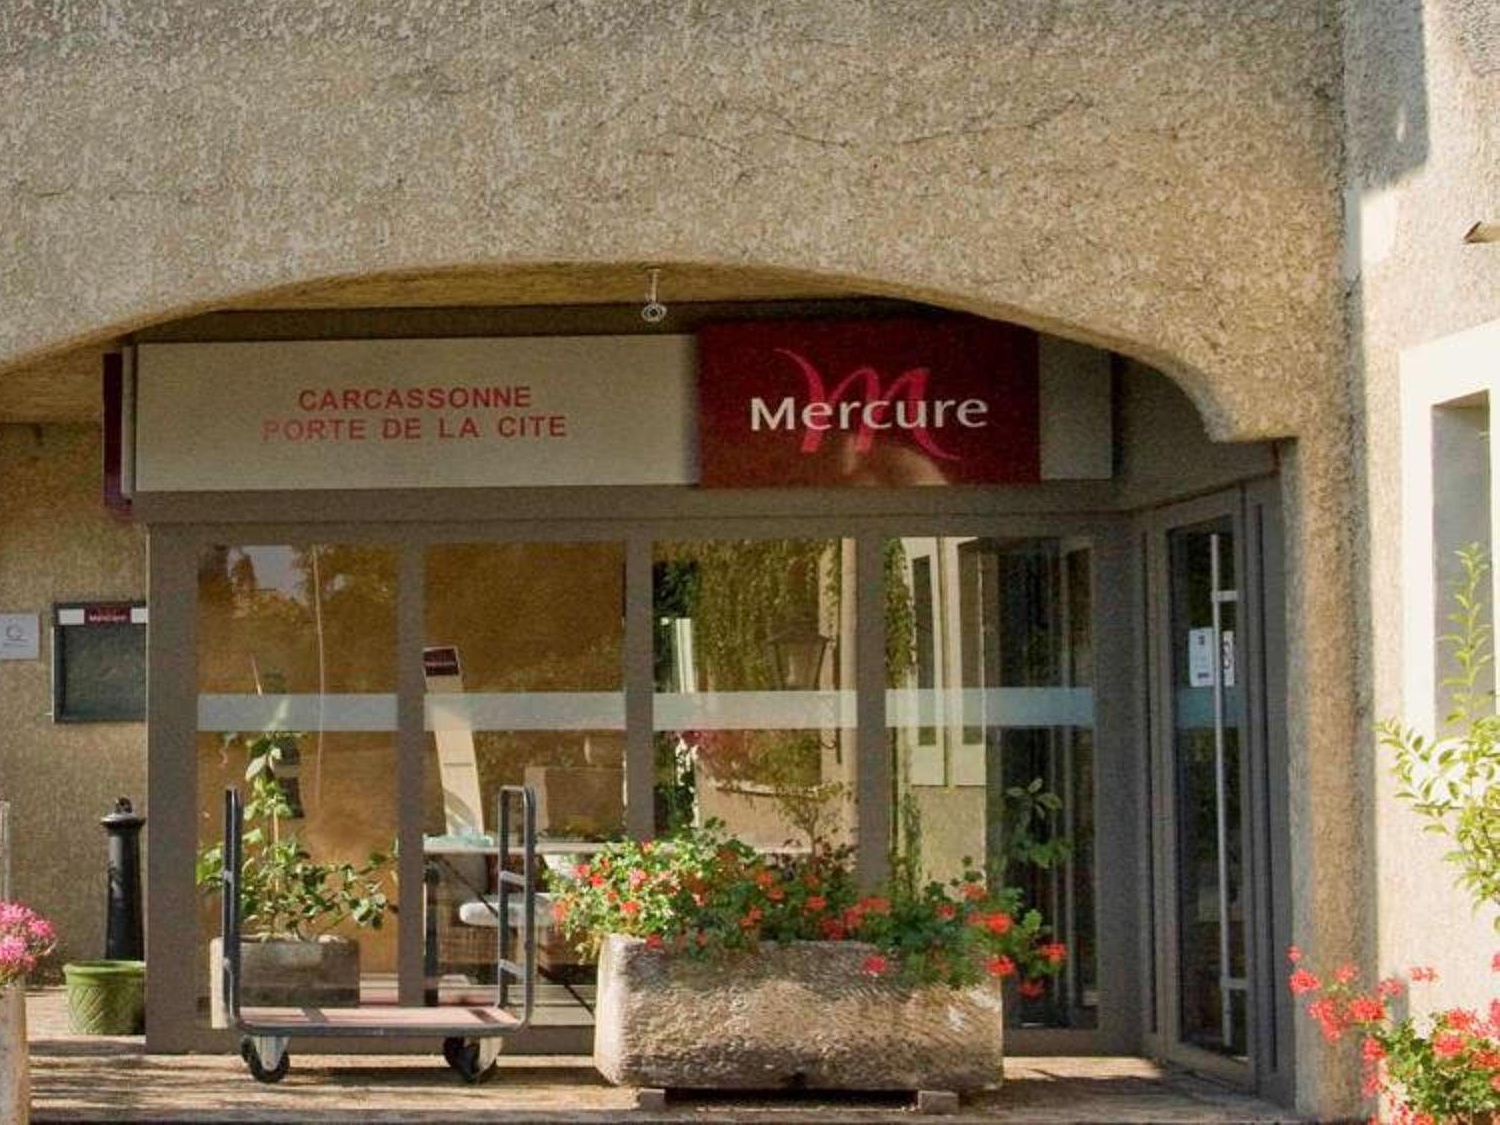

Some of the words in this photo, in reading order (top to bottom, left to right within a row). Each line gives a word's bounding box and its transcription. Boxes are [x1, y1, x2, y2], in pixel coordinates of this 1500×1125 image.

[299, 386, 530, 411] CARCASSONNE
[750, 396, 988, 430] Mercure
[261, 419, 364, 441] PORTE
[382, 418, 420, 440] DE
[439, 417, 478, 438] LA
[497, 416, 566, 437] CITE
